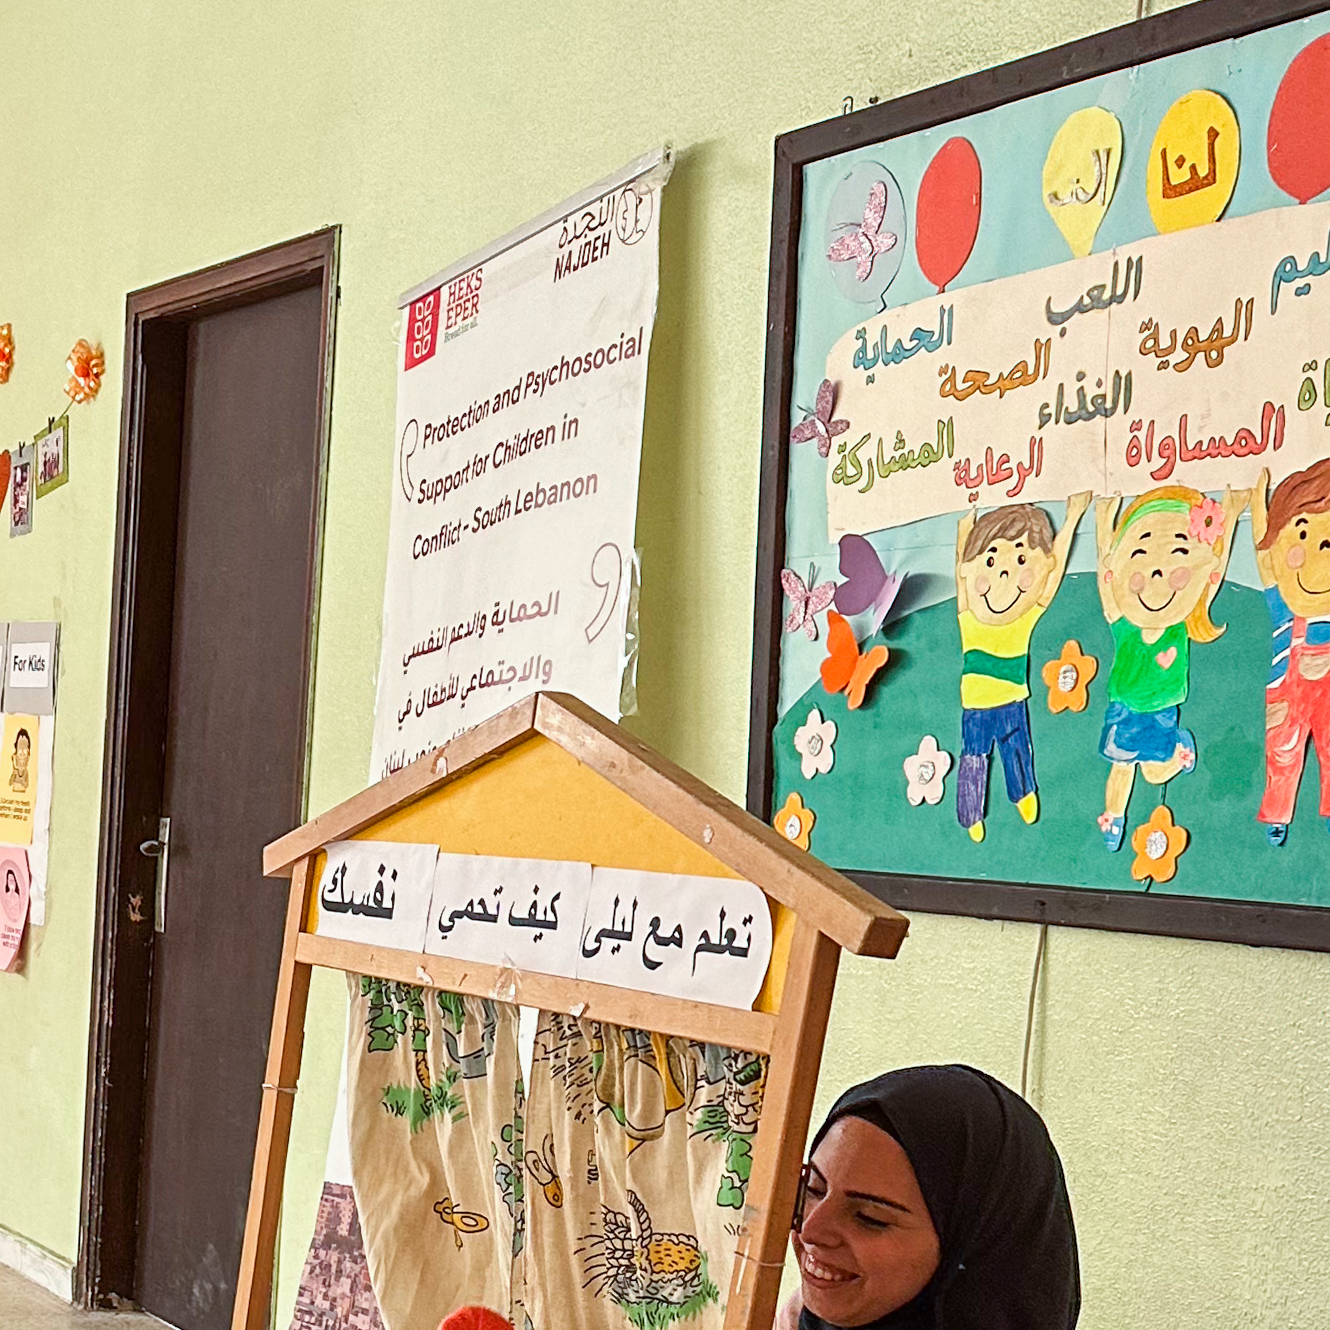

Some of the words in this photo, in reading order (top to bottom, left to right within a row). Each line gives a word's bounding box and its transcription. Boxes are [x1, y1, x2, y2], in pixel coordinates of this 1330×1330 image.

[1160, 126, 1220, 200] لنا
[558, 195, 616, 249] النجدة
[553, 229, 612, 283] NAJDEH
[445, 293, 479, 330] EPER
[447, 268, 484, 307] HEKS
[1045, 255, 1143, 338] اللعب
[853, 304, 954, 386] الحماية
[1139, 298, 1255, 372] الهوية
[423, 398, 490, 449] Protection
[492, 377, 523, 414] and
[523, 326, 644, 399] Psychosocial
[939, 337, 1052, 401] الصحة
[1037, 369, 1133, 431] الغذاء
[417, 459, 471, 505] Support
[471, 453, 490, 480] for
[492, 423, 557, 469] Children
[561, 412, 580, 441] in
[831, 416, 956, 494] المشاركة
[953, 436, 1044, 503] الرعاية
[1125, 401, 1287, 480] المساواة
[412, 518, 462, 560] Conflict
[471, 494, 512, 533] South
[513, 472, 599, 516] Lebanon
[448, 610, 487, 656] والدعم
[491, 589, 561, 634] الحماية
[13, 655, 27, 672] For
[28, 654, 46, 672] Kids
[402, 624, 449, 675] النفسي
[397, 691, 412, 731] في
[415, 673, 460, 718] للأطفال
[460, 654, 554, 709] والاجتماعي
[320, 861, 399, 921] نفسك
[438, 885, 504, 940] تحمي
[508, 884, 563, 943] كيف
[582, 896, 639, 958] ليلى
[640, 915, 684, 971] مع
[692, 906, 753, 977] تعلم
